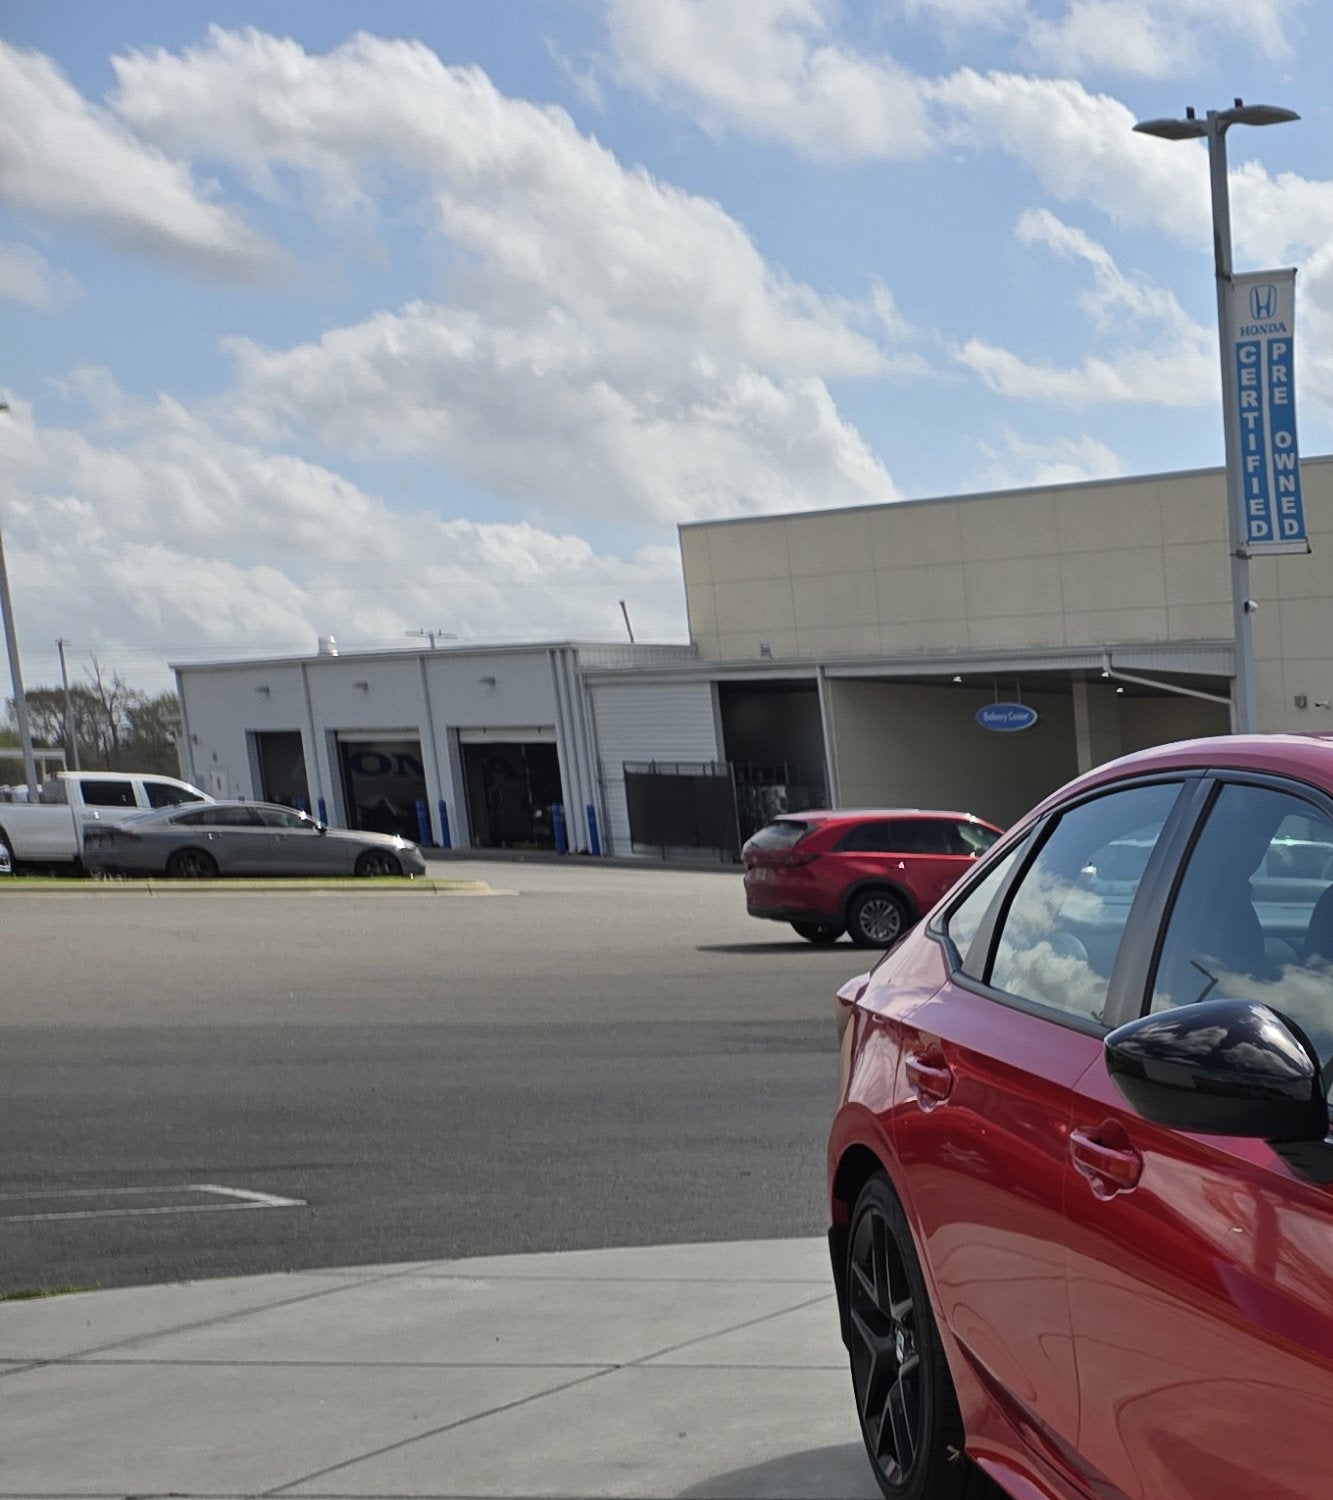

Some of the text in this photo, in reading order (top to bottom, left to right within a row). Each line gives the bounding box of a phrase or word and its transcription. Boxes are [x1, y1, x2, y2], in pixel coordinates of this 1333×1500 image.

[1240, 322, 1287, 336] HONDA
[1239, 345, 1268, 537] CERTIFIED
[1272, 342, 1299, 536] PRE OWNED
